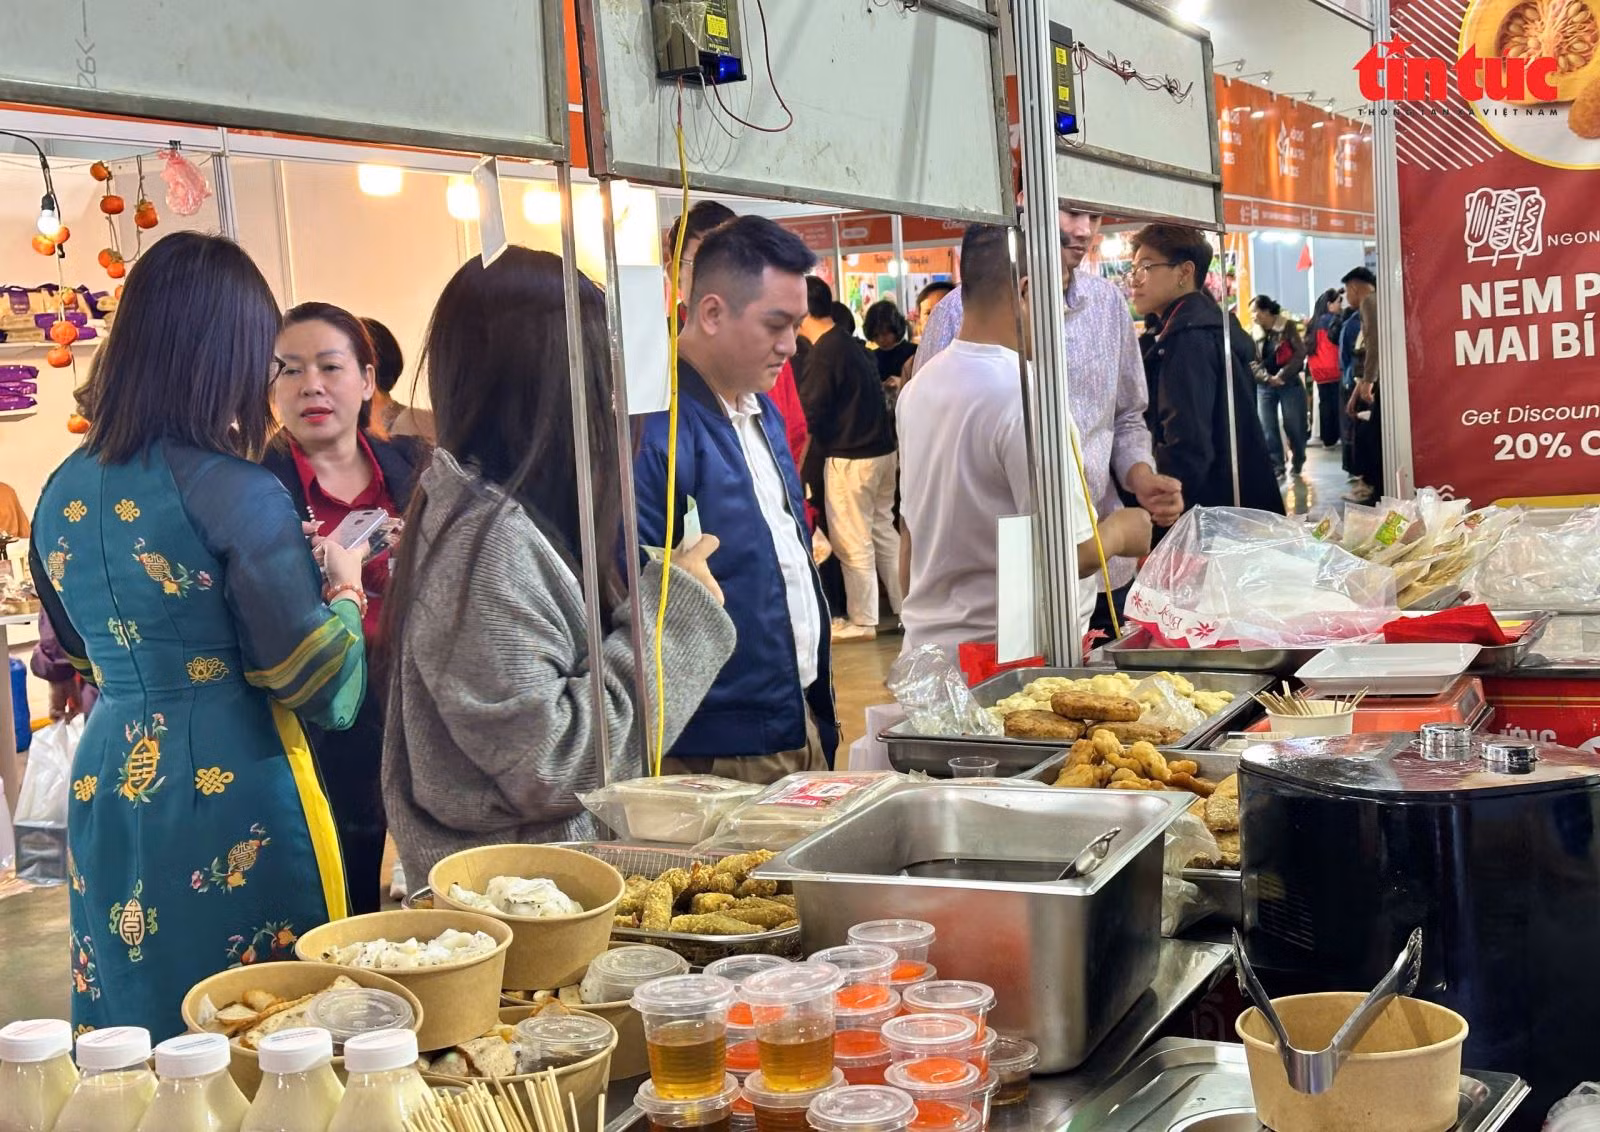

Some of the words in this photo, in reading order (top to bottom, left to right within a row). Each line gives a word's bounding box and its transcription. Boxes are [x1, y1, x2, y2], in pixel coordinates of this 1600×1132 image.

[1547, 230, 1600, 247] NGON
[1461, 275, 1563, 320] NEM
[1454, 324, 1539, 366] MAI
[1551, 312, 1596, 360] BÍ
[1461, 408, 1501, 426] Get
[1507, 404, 1600, 424] Discoun
[1493, 432, 1573, 461] 20%
